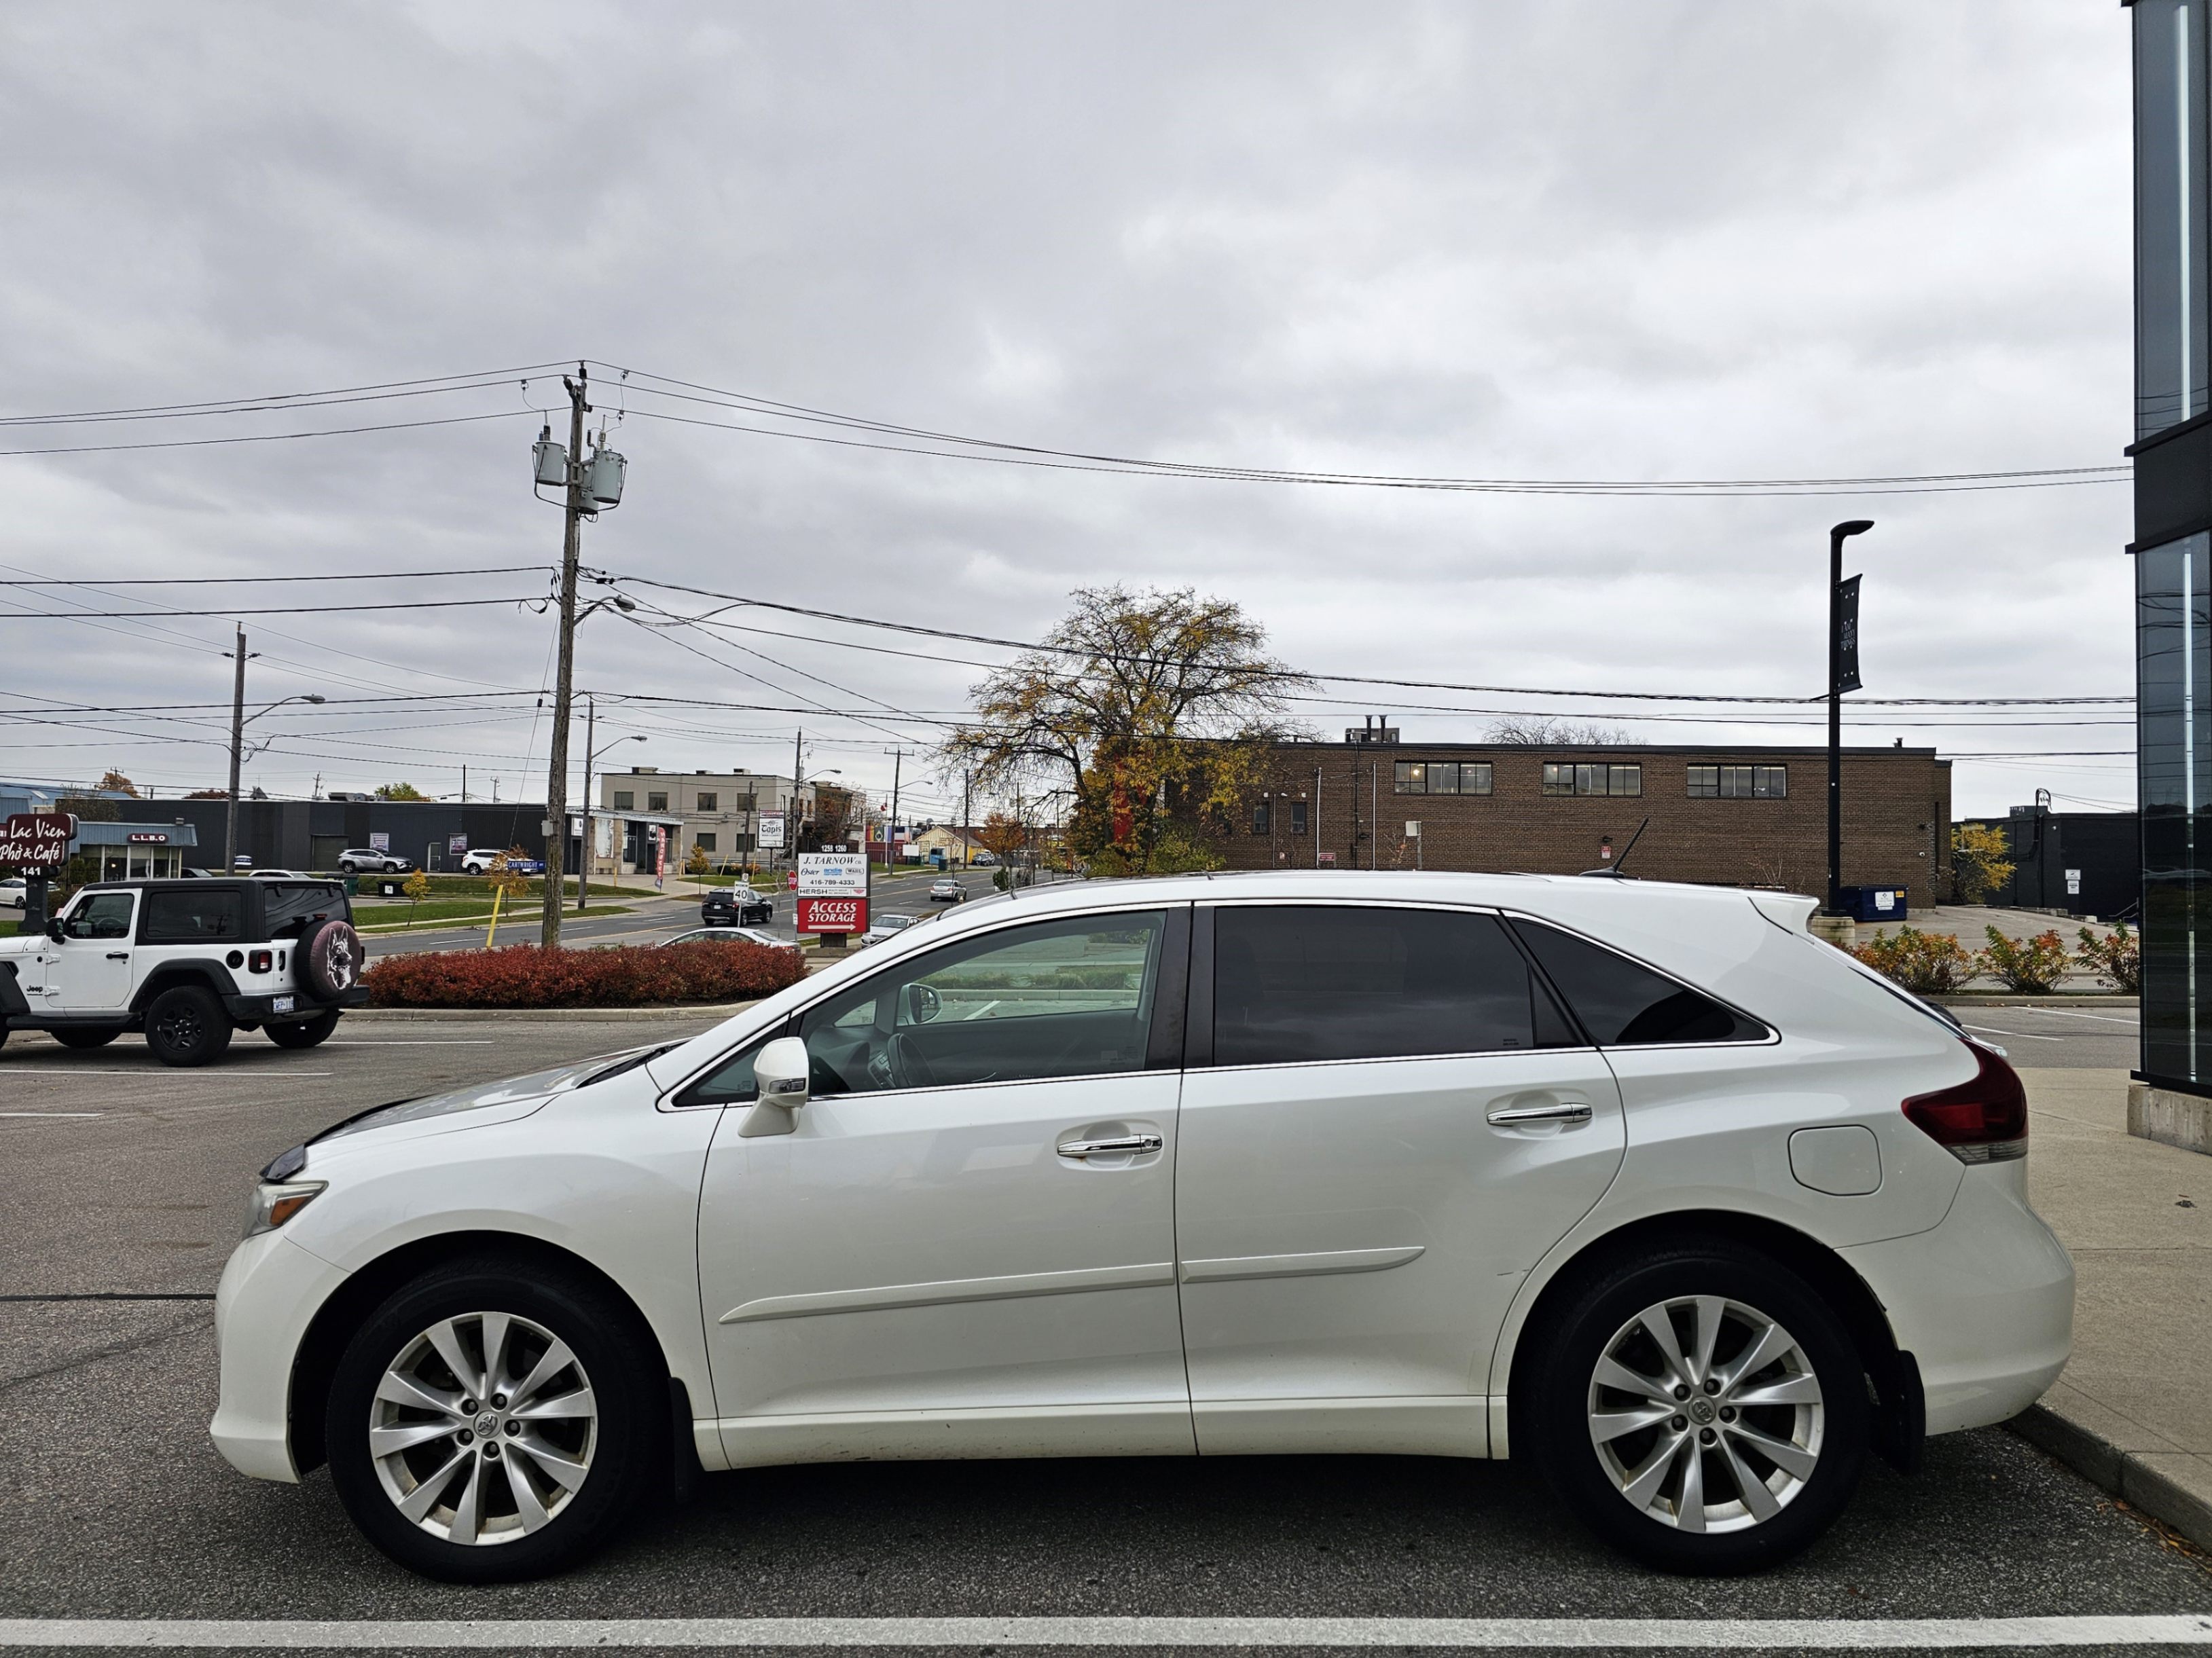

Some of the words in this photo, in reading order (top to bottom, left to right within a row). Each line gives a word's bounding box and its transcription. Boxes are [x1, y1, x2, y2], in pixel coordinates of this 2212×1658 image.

[10, 819, 33, 839] Lac
[36, 818, 66, 839] Vien
[23, 847, 33, 860] &
[34, 841, 60, 865] Café
[814, 856, 856, 864] TARNOW
[21, 866, 41, 875] 141
[801, 868, 820, 876] Oster
[735, 890, 747, 899] 40
[808, 901, 857, 913] ACCESS
[808, 913, 856, 922] STORAGE
[26, 984, 43, 993] Jeep
